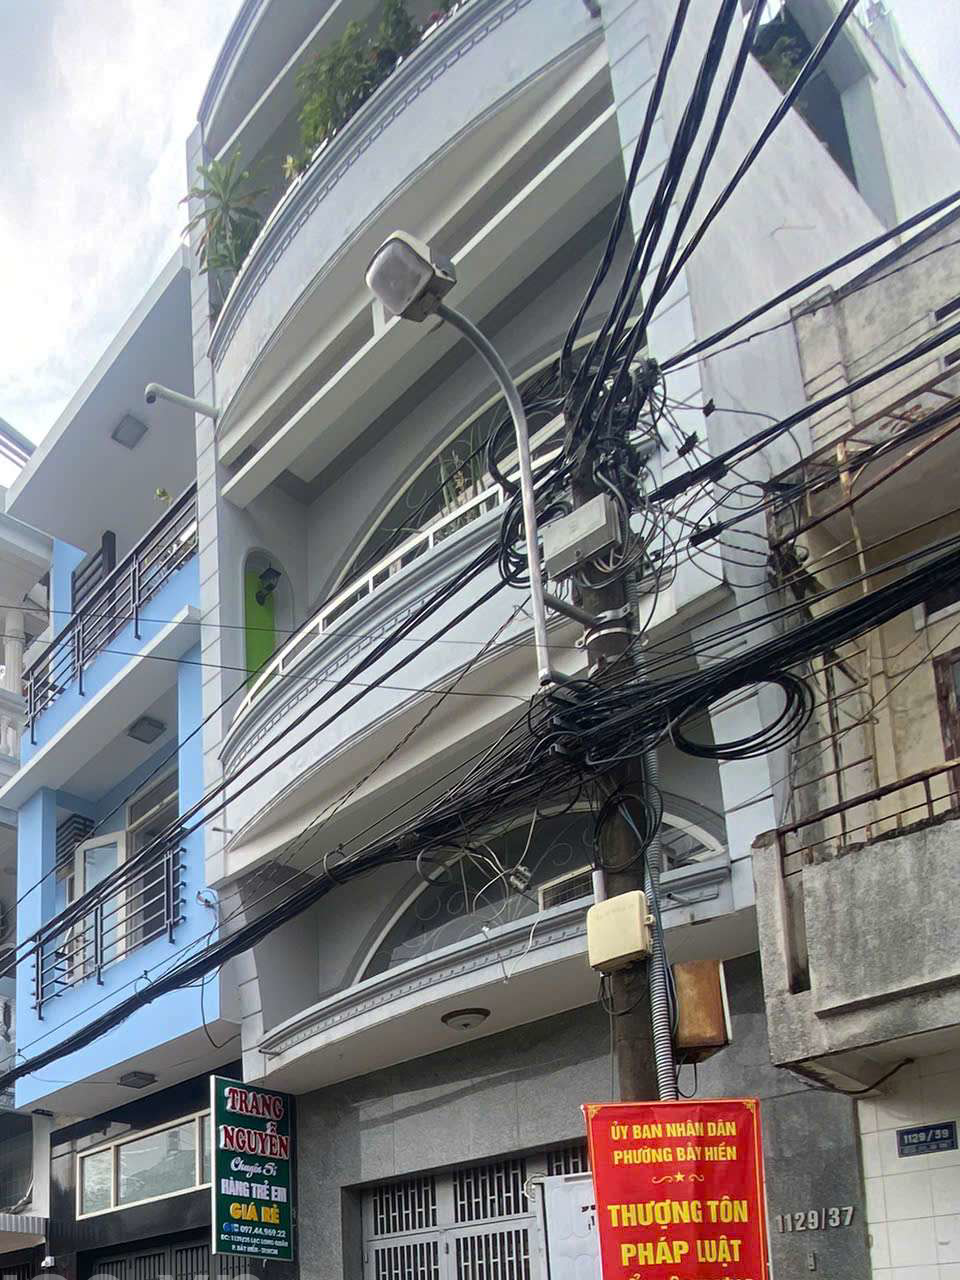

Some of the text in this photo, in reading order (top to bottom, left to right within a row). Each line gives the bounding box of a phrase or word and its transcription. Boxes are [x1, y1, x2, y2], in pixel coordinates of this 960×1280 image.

[224, 1087, 284, 1120] TRANG
[219, 1121, 289, 1160] NGUYỄN
[611, 1119, 737, 1140] ỦY BAN NHÂN DÂN
[231, 1156, 262, 1178] Chuyên
[613, 1146, 673, 1165] PHƯỜNG
[221, 1176, 288, 1203] HÀNG TRẺ EM
[230, 1202, 280, 1224] GIÁ RẺ
[607, 1199, 703, 1229] THƯỢNG
[707, 1195, 748, 1224] TÔN
[776, 1206, 854, 1234] 1129/37
[620, 1235, 742, 1267] PHÁP LUẬT
